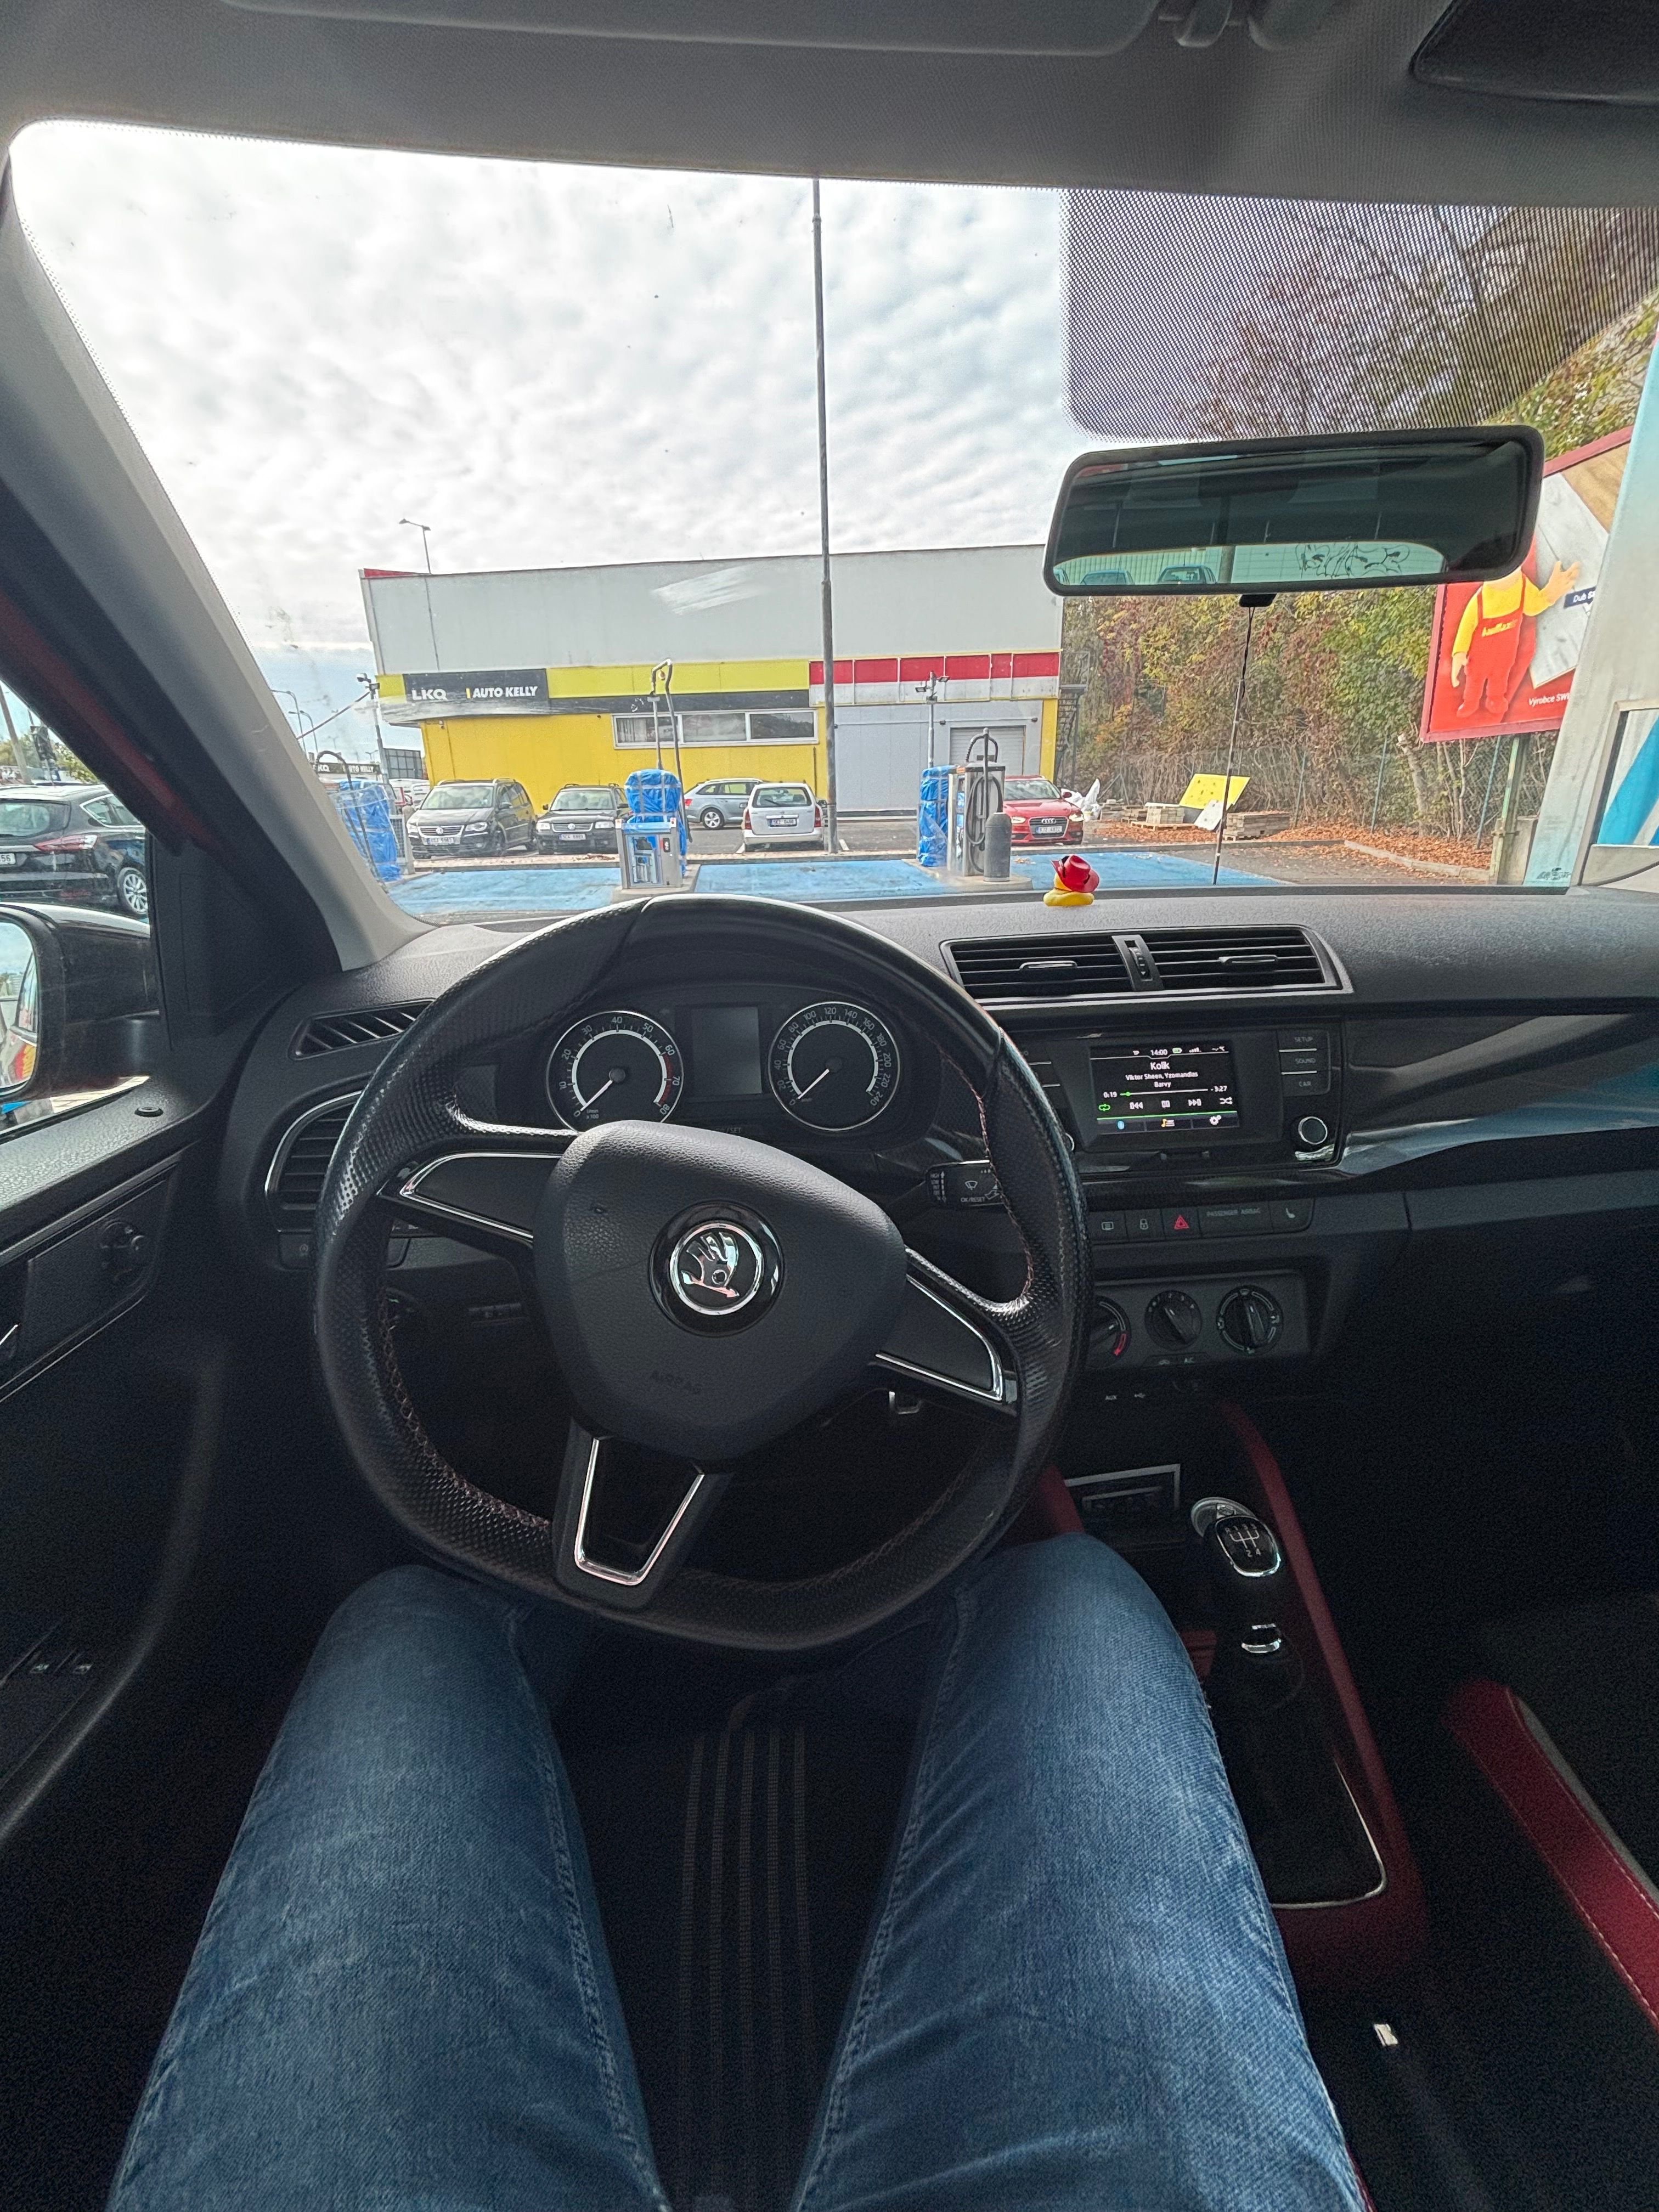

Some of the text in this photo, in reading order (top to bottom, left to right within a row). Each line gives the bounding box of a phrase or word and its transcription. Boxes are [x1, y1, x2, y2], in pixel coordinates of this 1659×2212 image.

[411, 686, 538, 701] LKQ AUTO KELLY
[1528, 696, 1555, 708] Výrobce
[803, 1011, 816, 1020] 100
[844, 1009, 857, 1019] 140
[642, 1023, 653, 1032] 50
[788, 1022, 799, 1032] 80
[863, 1018, 875, 1030] 160
[583, 1025, 592, 1034] 30
[876, 1033, 887, 1047] 180
[665, 1045, 675, 1056] 60
[777, 1040, 787, 1051] 60
[562, 1049, 571, 1059] 20
[774, 1060, 781, 1070] 40
[883, 1053, 891, 1068] 200
[558, 1081, 567, 1090] 10
[672, 1076, 680, 1086] 70
[881, 1073, 890, 1088] 220
[870, 1092, 884, 1107] 240
[659, 1104, 670, 1115] 80
[1246, 1549, 1253, 1558] 2
[1255, 1548, 1262, 1556] 4
